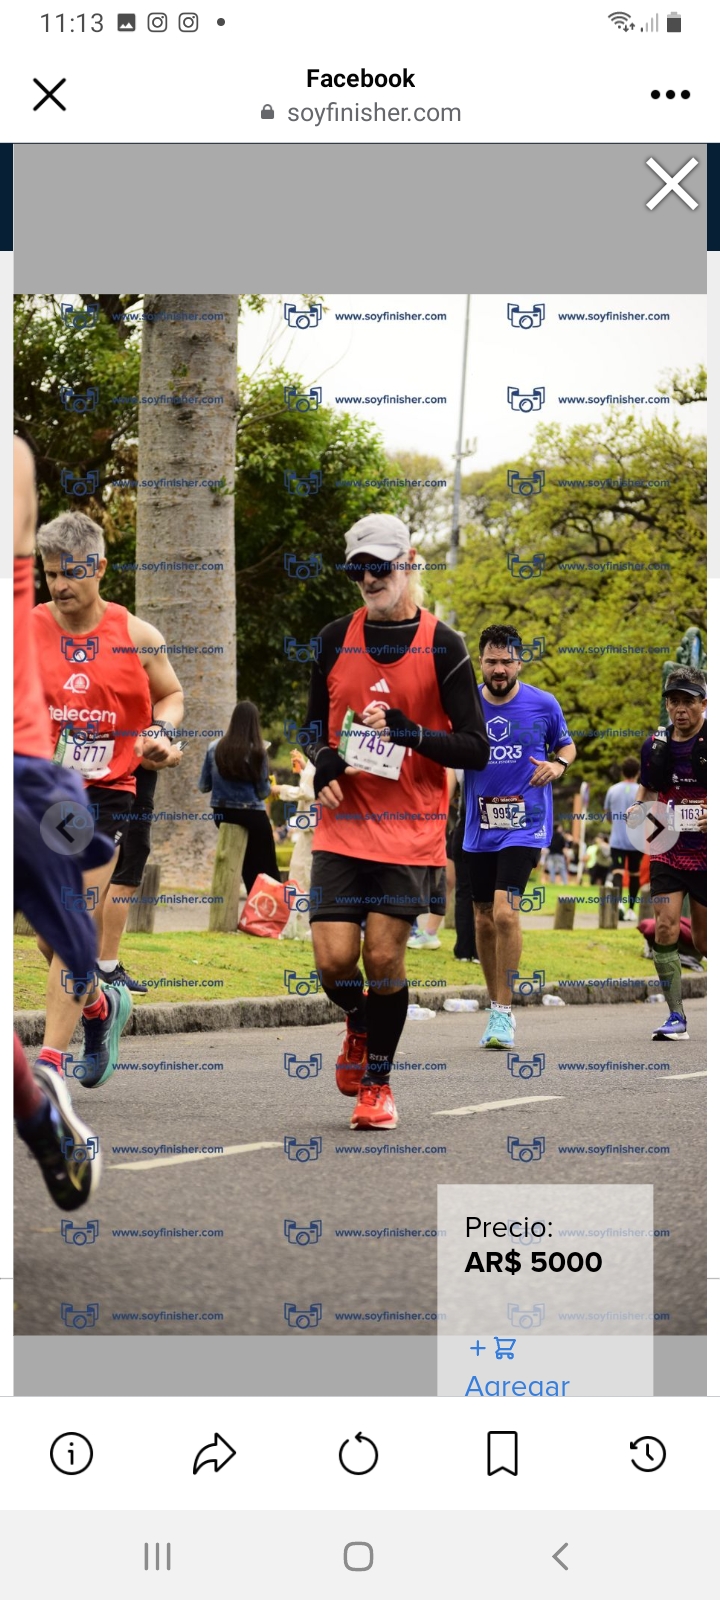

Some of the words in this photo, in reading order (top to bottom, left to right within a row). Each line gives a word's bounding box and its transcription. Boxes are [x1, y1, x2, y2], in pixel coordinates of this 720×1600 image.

[40, 13, 104, 33] 11:13
[306, 68, 416, 89] Facebook
[287, 101, 461, 128] soyfinisher.com
[49, 705, 117, 725] telecom
[73, 745, 107, 763] 6777
[465, 1216, 553, 1238] Precio:
[464, 1248, 522, 1276] AR$
[531, 1251, 603, 1273] 5000
[464, 1375, 571, 1397] Agregar
